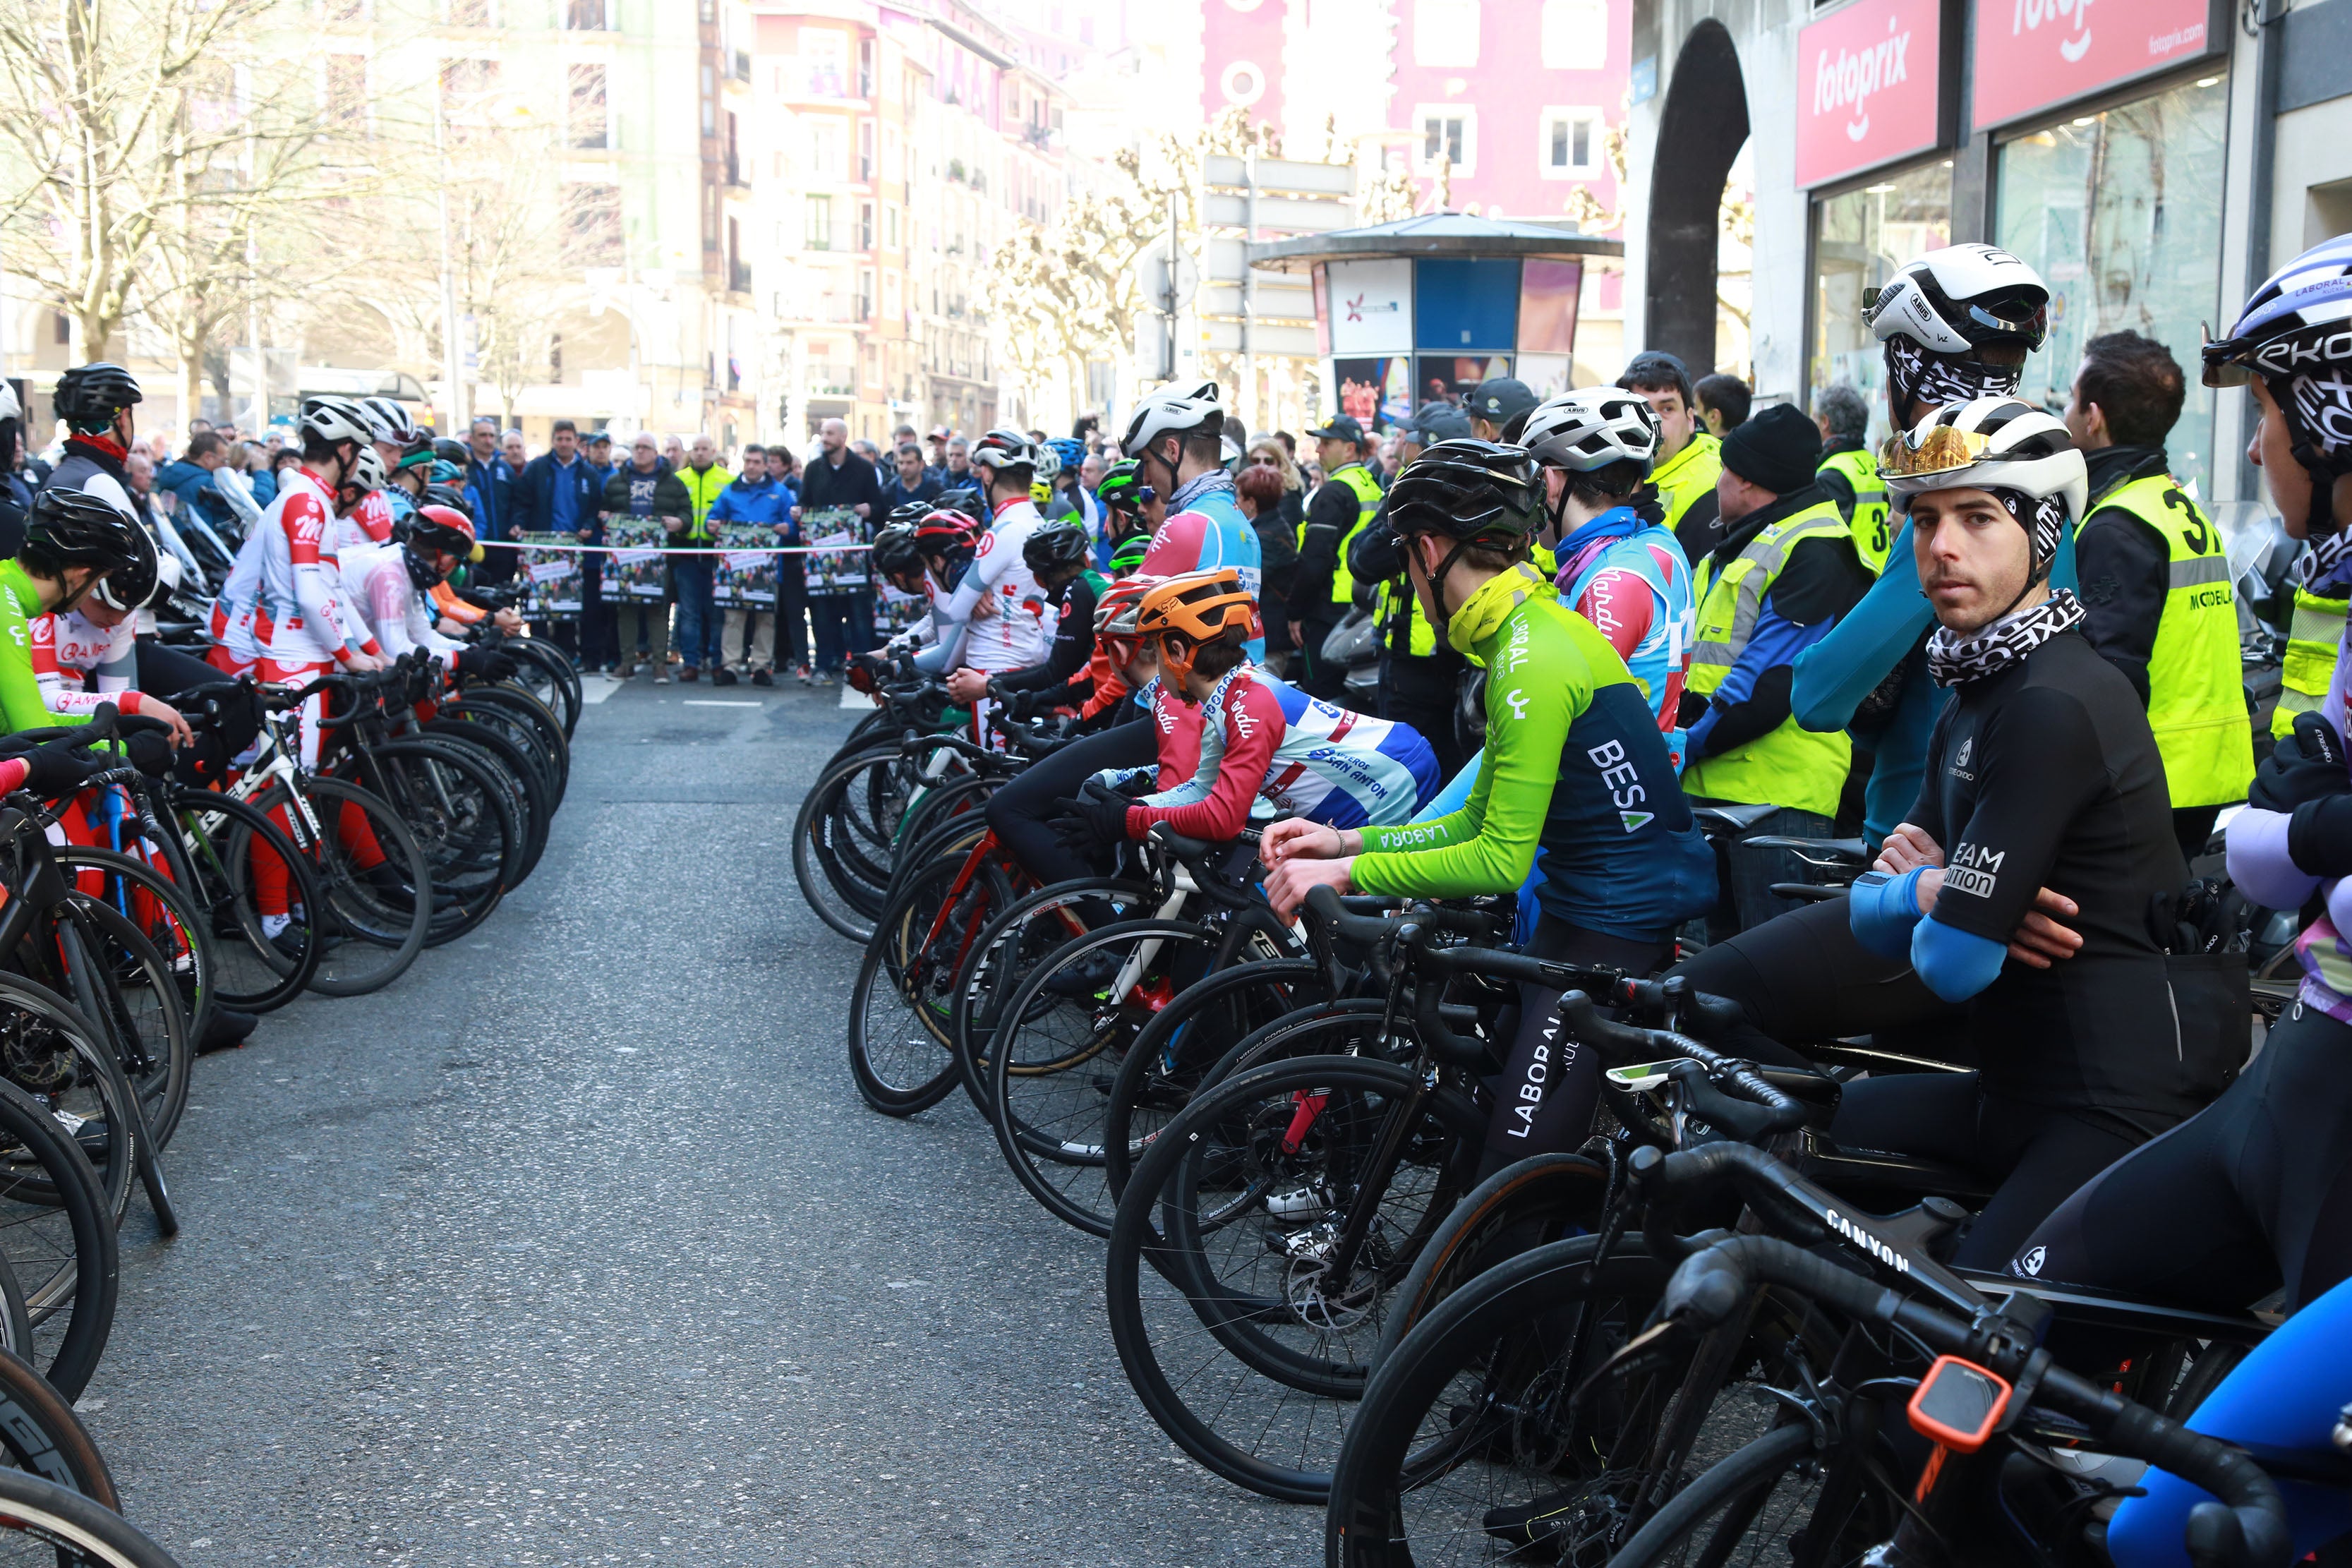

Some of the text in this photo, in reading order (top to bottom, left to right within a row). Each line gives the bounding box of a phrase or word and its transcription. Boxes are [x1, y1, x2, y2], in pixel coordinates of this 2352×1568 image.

[2149, 23, 2203, 55] fotoprix.com
[1814, 15, 1911, 116] fotoprix
[2295, 278, 2344, 297] LABORAL
[1912, 297, 1929, 319] ABUS
[1872, 507, 1887, 553] 3
[1337, 752, 1370, 770] VIVEROS
[2315, 728, 2333, 763] ETXEONDO
[1327, 756, 1389, 800] SAN ANTON
[1588, 739, 1655, 833] BESA
[288, 812, 303, 841] TREK
[299, 793, 322, 831] TREK
[1239, 1041, 1263, 1060] vittoria
[1264, 1024, 1292, 1042] CORSA
[1208, 1190, 1248, 1219] BONTRAGER
[1827, 1209, 1909, 1272] CANYON
[1609, 1521, 1624, 1543] GALFER
